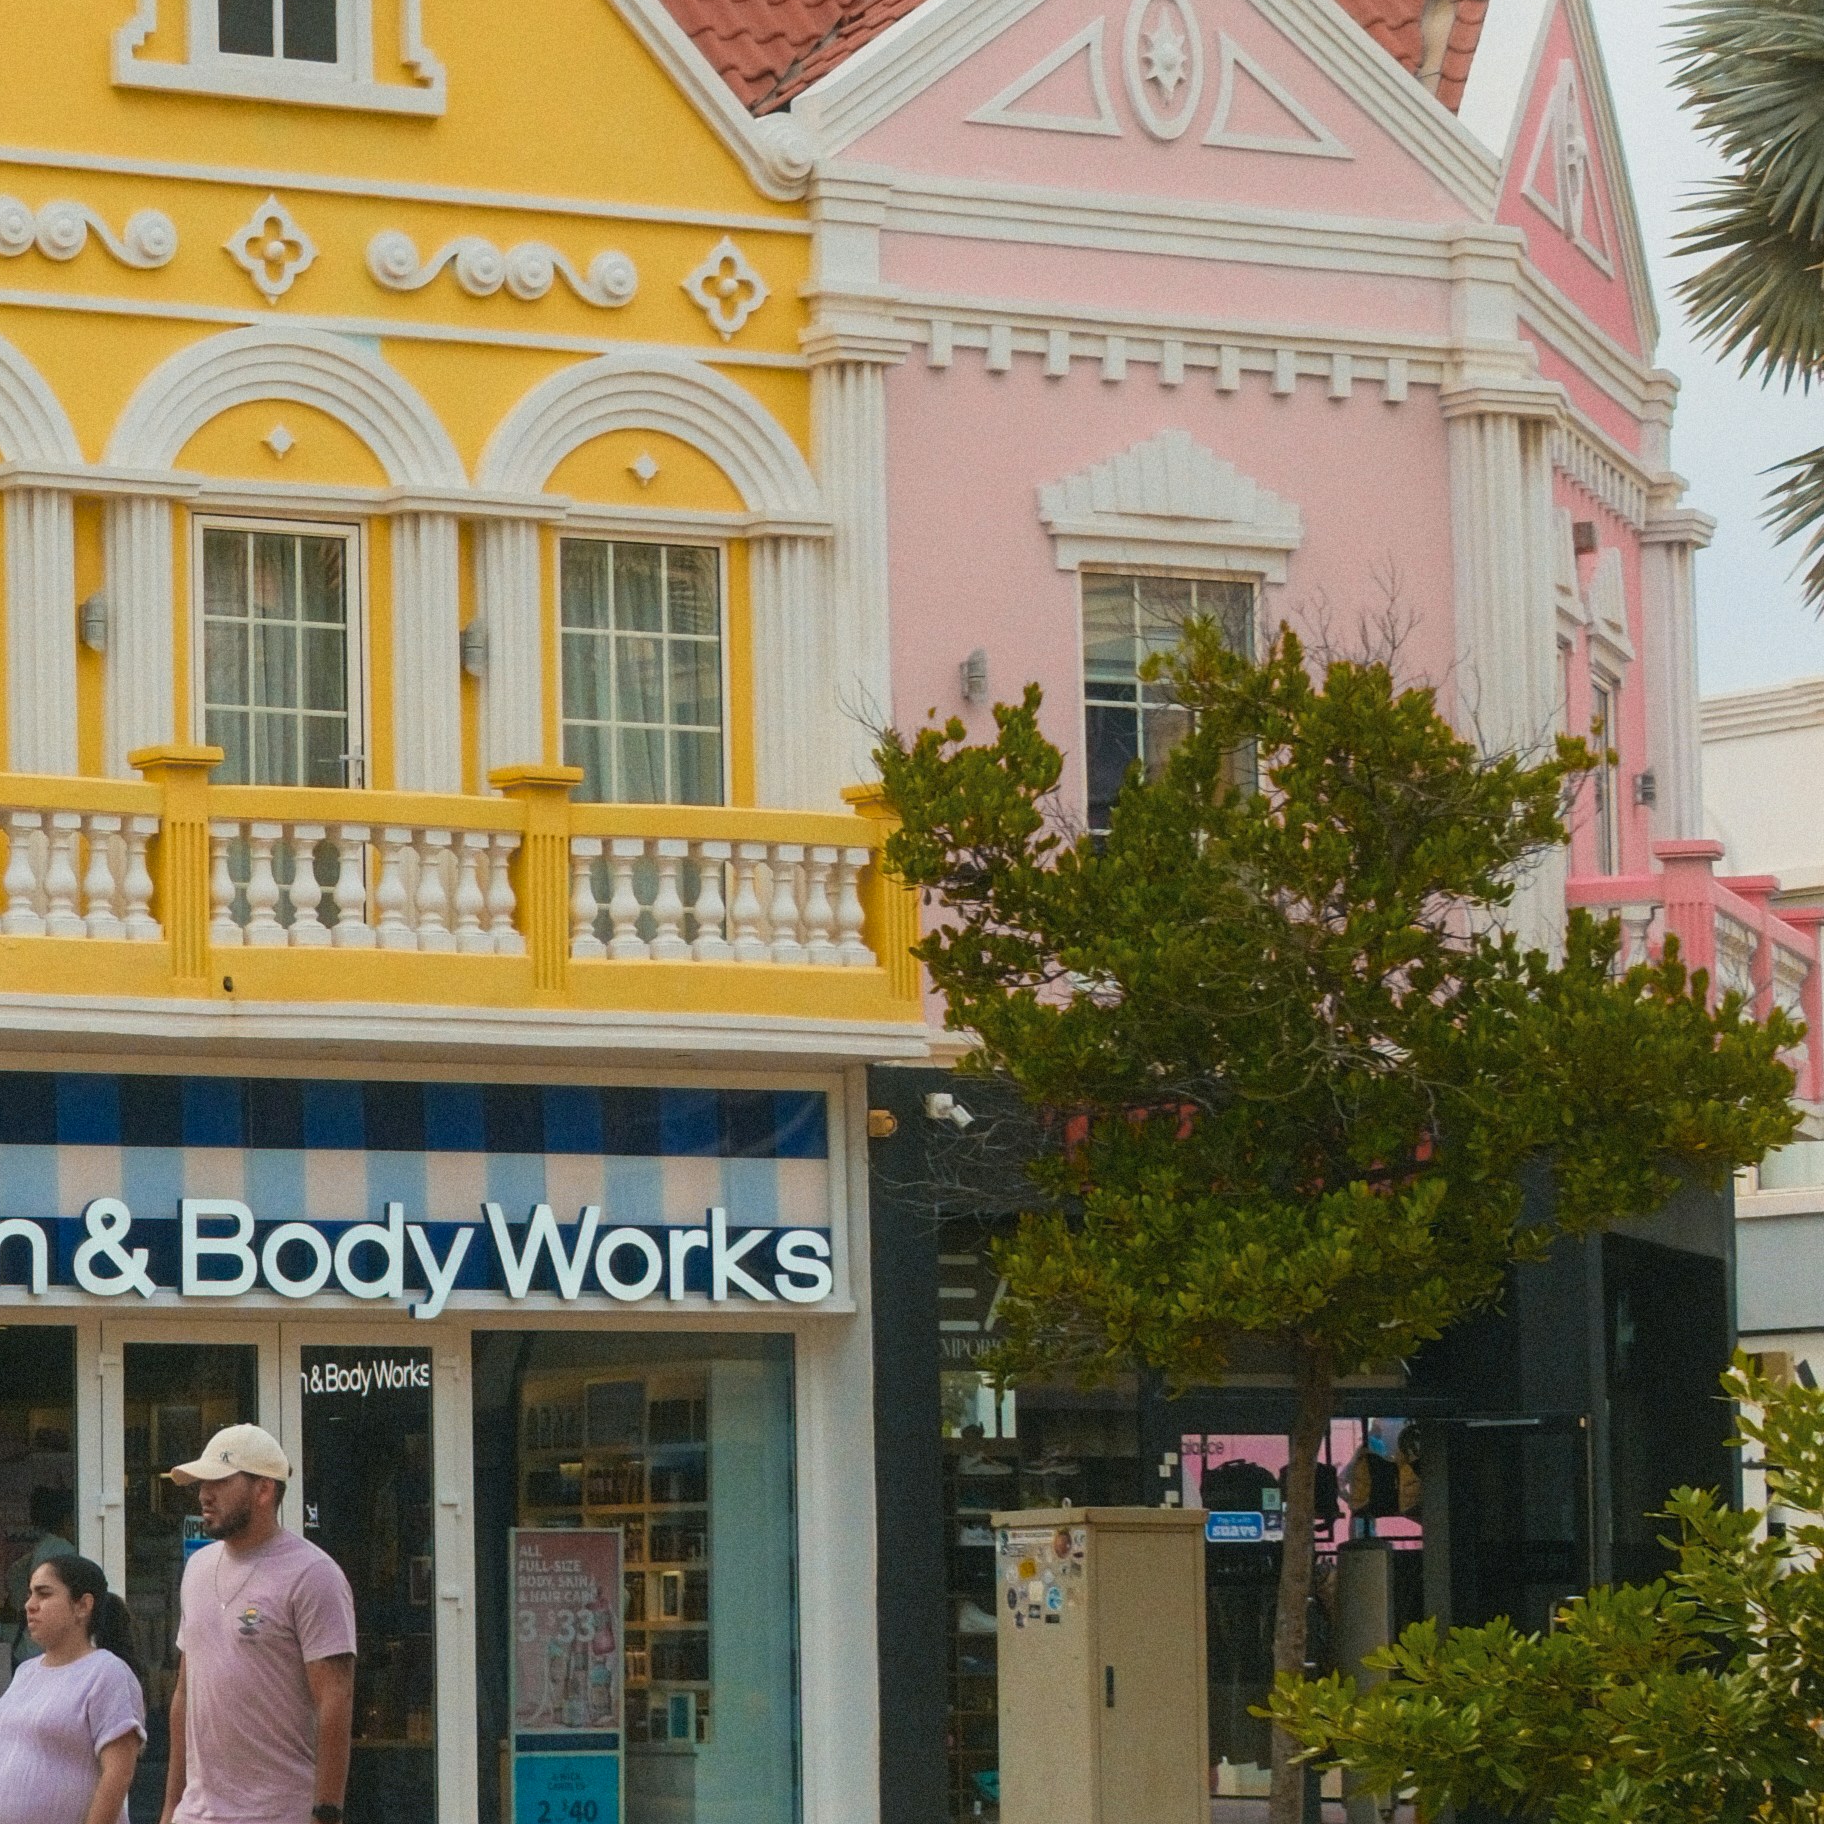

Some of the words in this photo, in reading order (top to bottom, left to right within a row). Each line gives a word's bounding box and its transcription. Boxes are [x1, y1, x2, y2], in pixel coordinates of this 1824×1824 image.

[73, 1197, 156, 1299] &
[178, 1197, 474, 1319] Body
[482, 1201, 833, 1304] Works
[310, 1364, 324, 1393] &
[326, 1361, 373, 1397] Body
[373, 1359, 430, 1389] Works
[519, 1544, 542, 1557] ALL
[518, 1609, 537, 1642] 3
[547, 1609, 596, 1643] $33
[537, 1800, 552, 1824] 2
